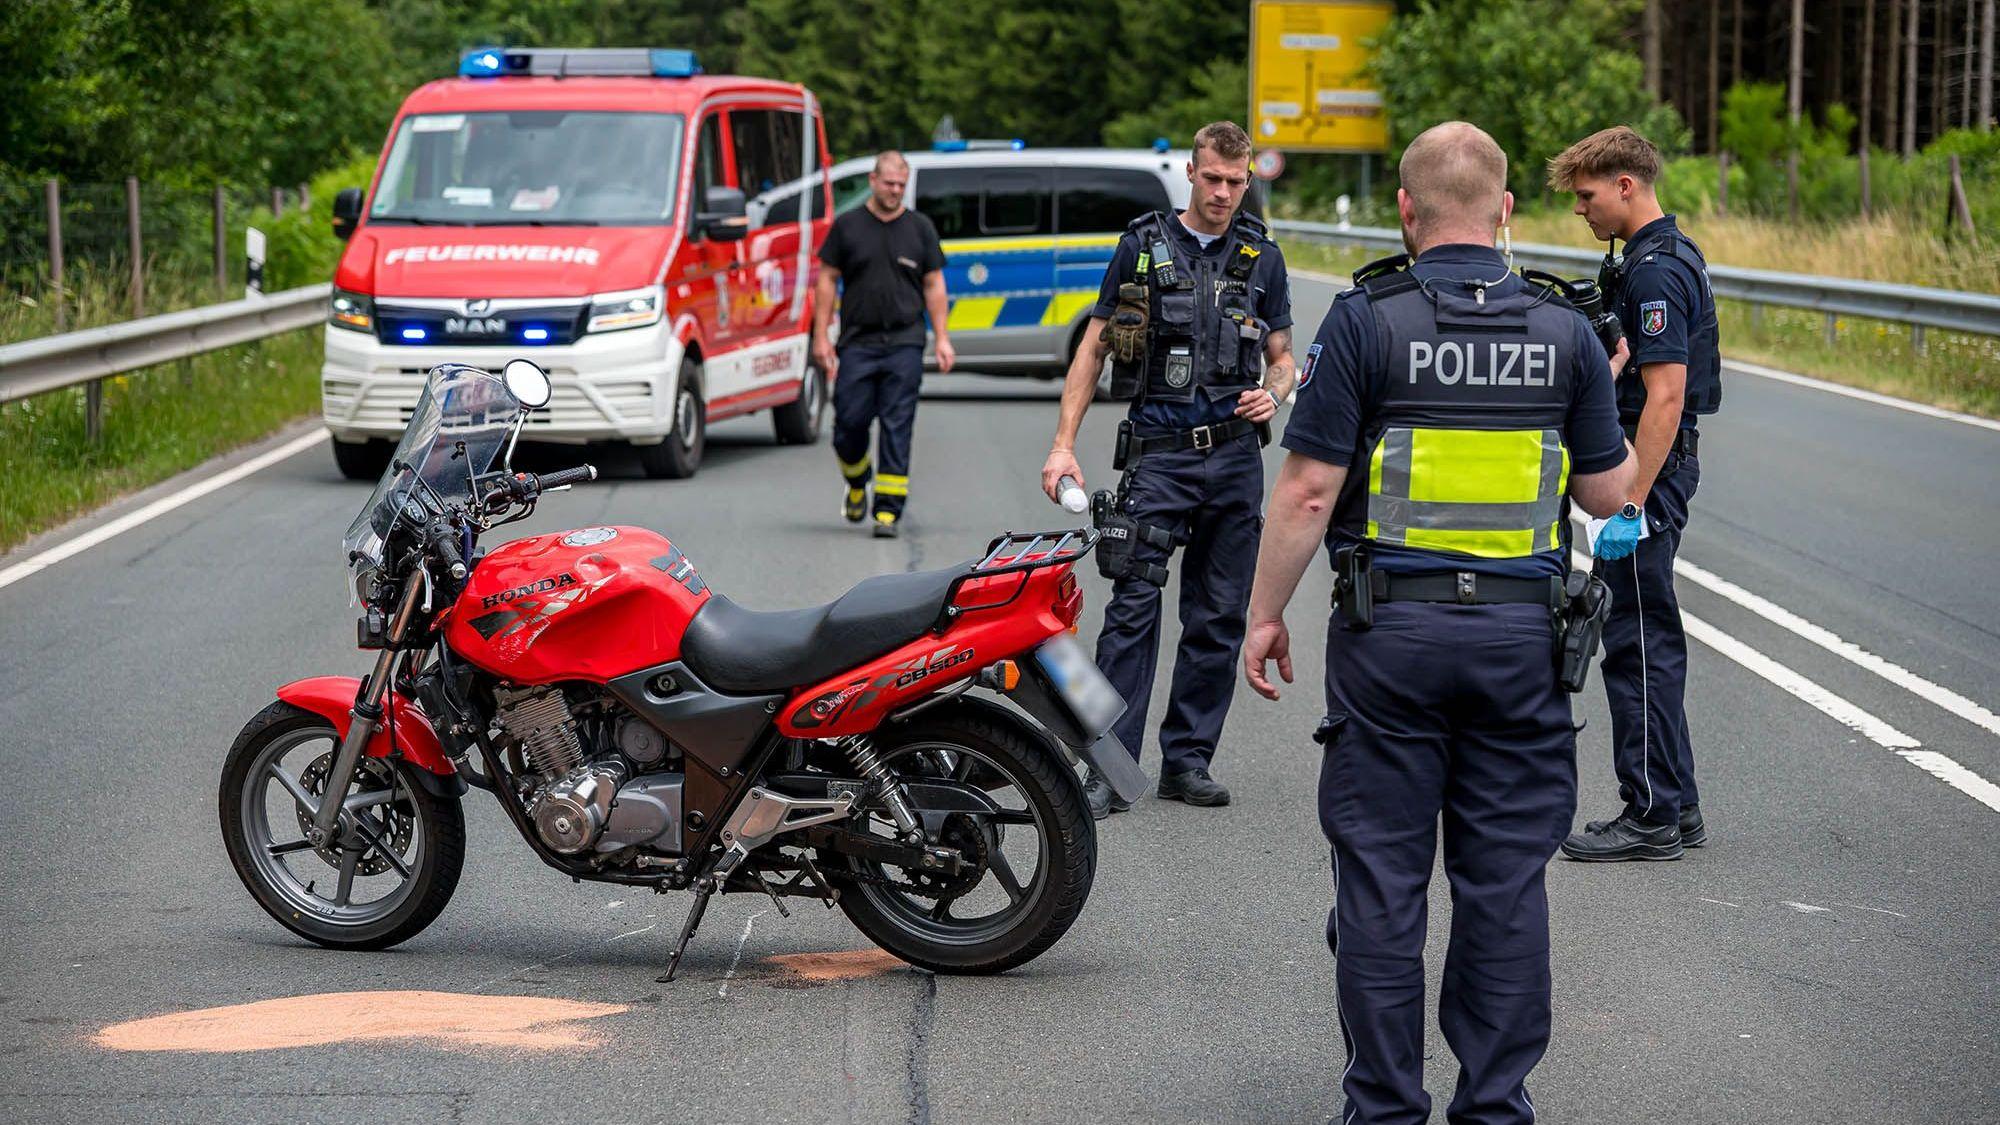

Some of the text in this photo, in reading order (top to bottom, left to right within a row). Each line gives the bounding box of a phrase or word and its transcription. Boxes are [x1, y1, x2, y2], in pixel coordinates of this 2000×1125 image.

[384, 245, 600, 266] FEUERWEHR
[445, 318, 506, 334] MAN
[1409, 341, 1556, 387] POLIZEI
[482, 571, 577, 610] HONDA
